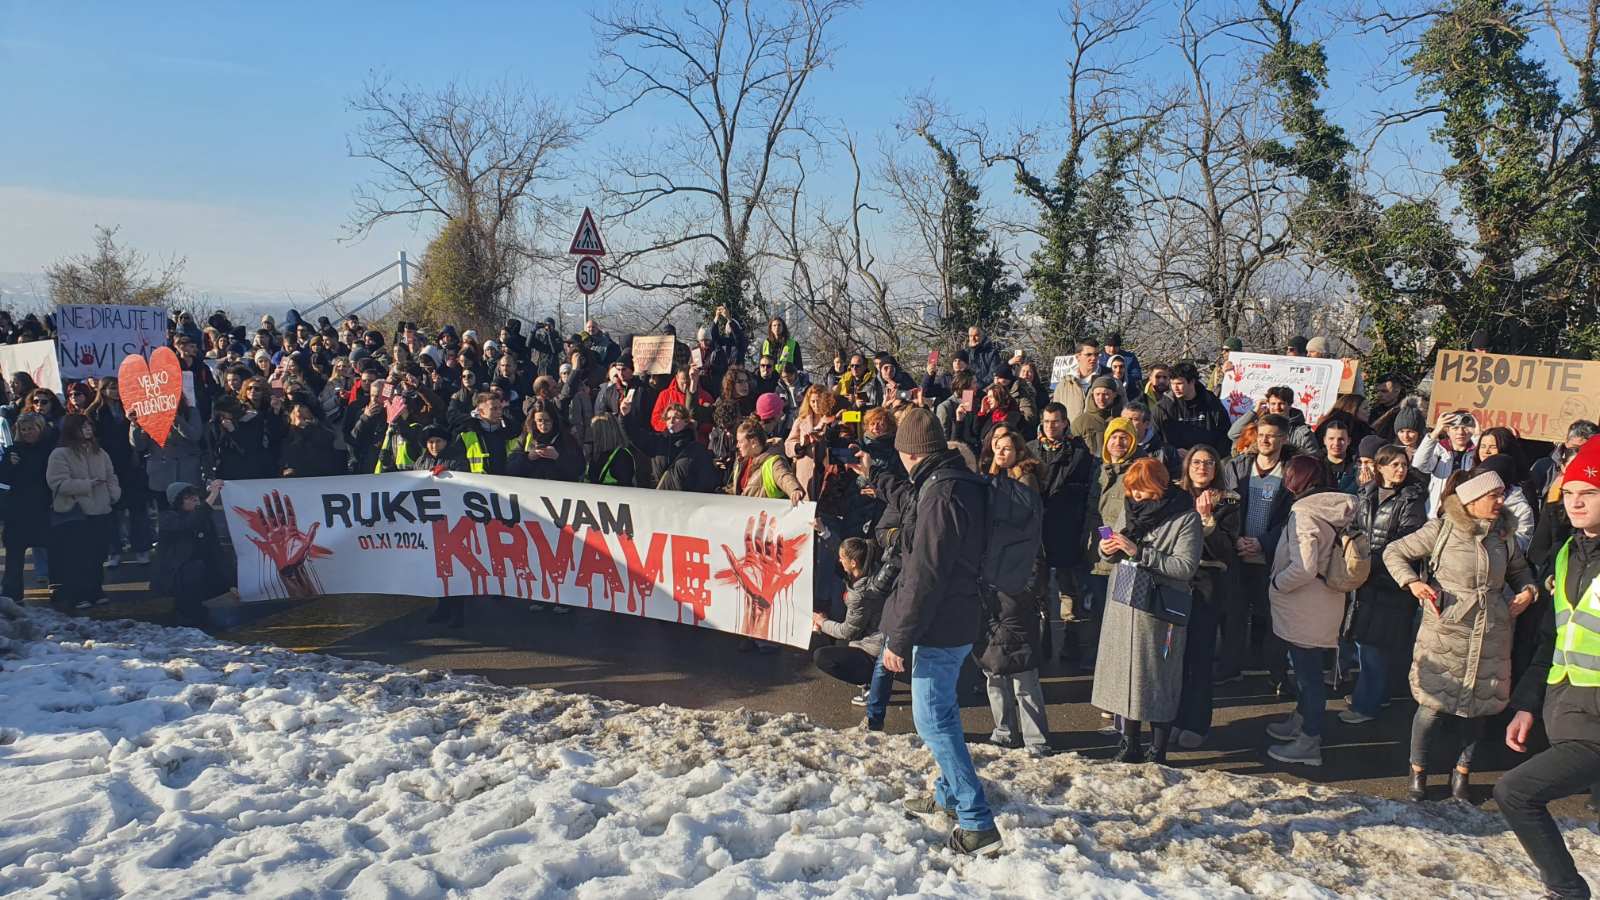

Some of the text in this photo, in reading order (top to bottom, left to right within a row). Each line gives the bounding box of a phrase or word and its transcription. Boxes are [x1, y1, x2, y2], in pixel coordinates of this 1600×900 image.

[580, 265, 596, 286] 50
[61, 306, 166, 331] NE DIRAJTE MI
[1473, 385, 1494, 408] У
[321, 488, 635, 541] RUKE SU VAM
[358, 531, 429, 551] 01.XI 2024.
[432, 515, 712, 624] KRVAVE
